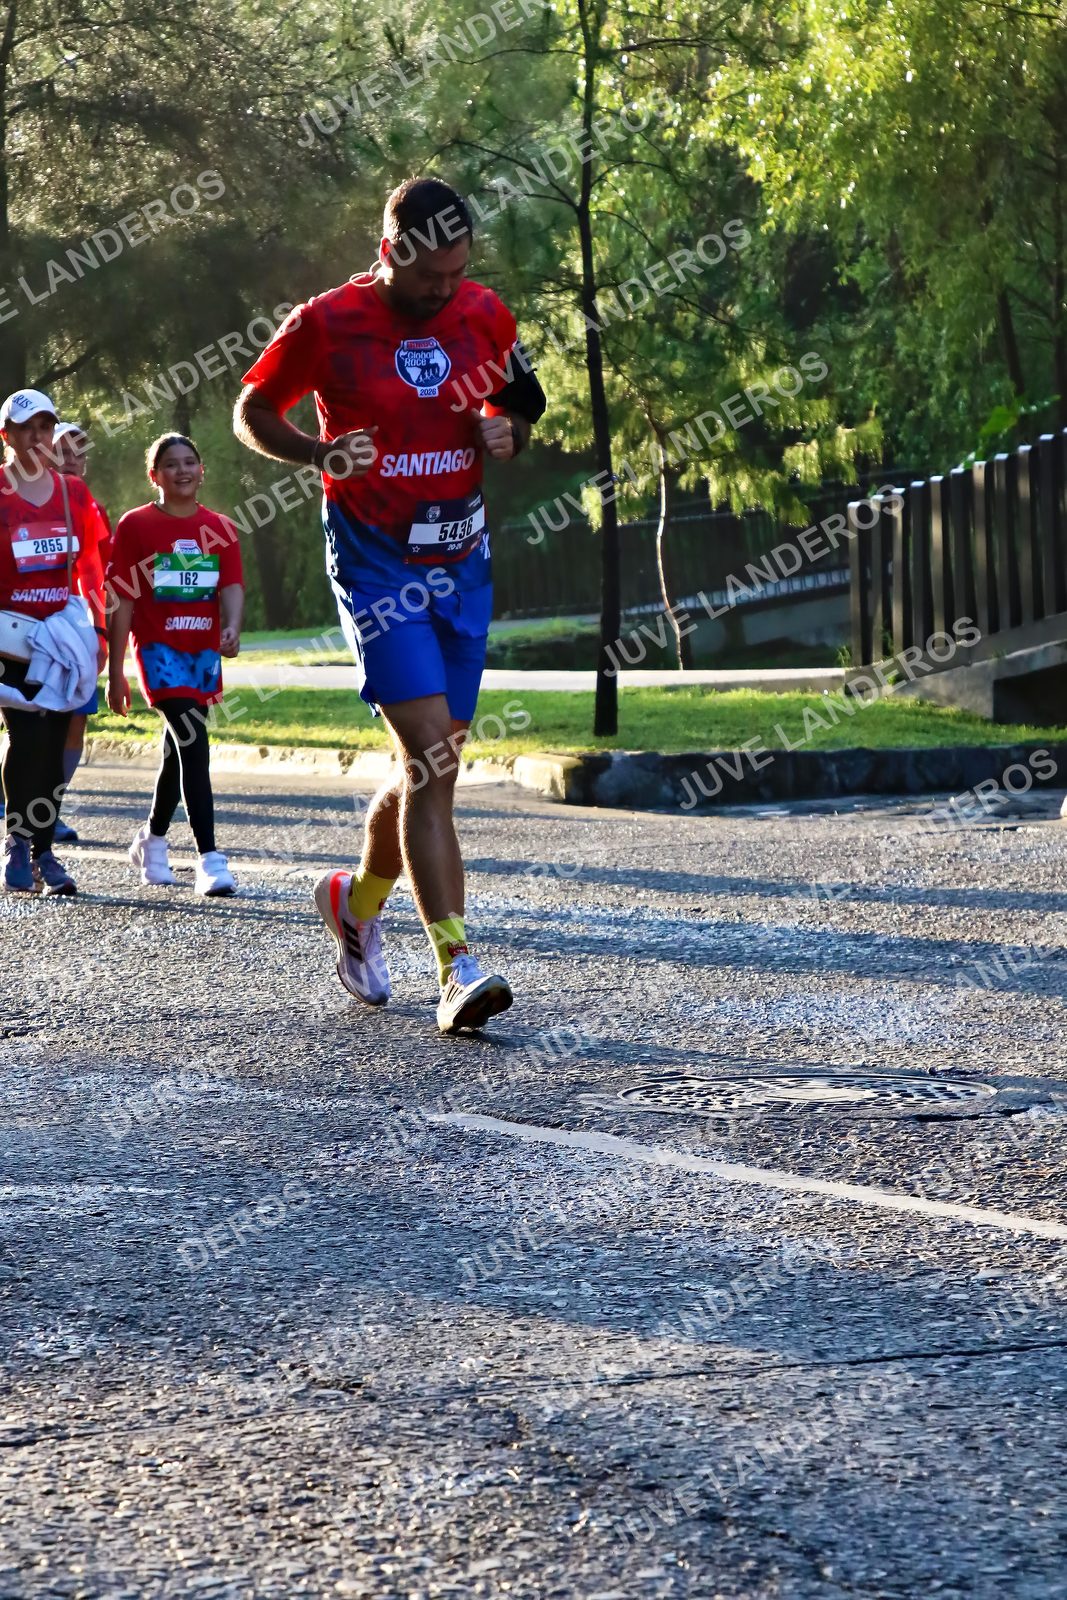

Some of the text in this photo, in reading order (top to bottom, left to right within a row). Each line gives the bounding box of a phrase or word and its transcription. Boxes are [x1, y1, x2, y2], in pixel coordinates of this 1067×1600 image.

[419, 387, 437, 396] 2026
[380, 450, 475, 477] SANTIAGO
[438, 516, 474, 542] 5436
[33, 538, 63, 554] 2855
[179, 571, 199, 586] 162
[11, 586, 69, 602] SANTIAGO
[165, 615, 213, 631] SANTIAGO
